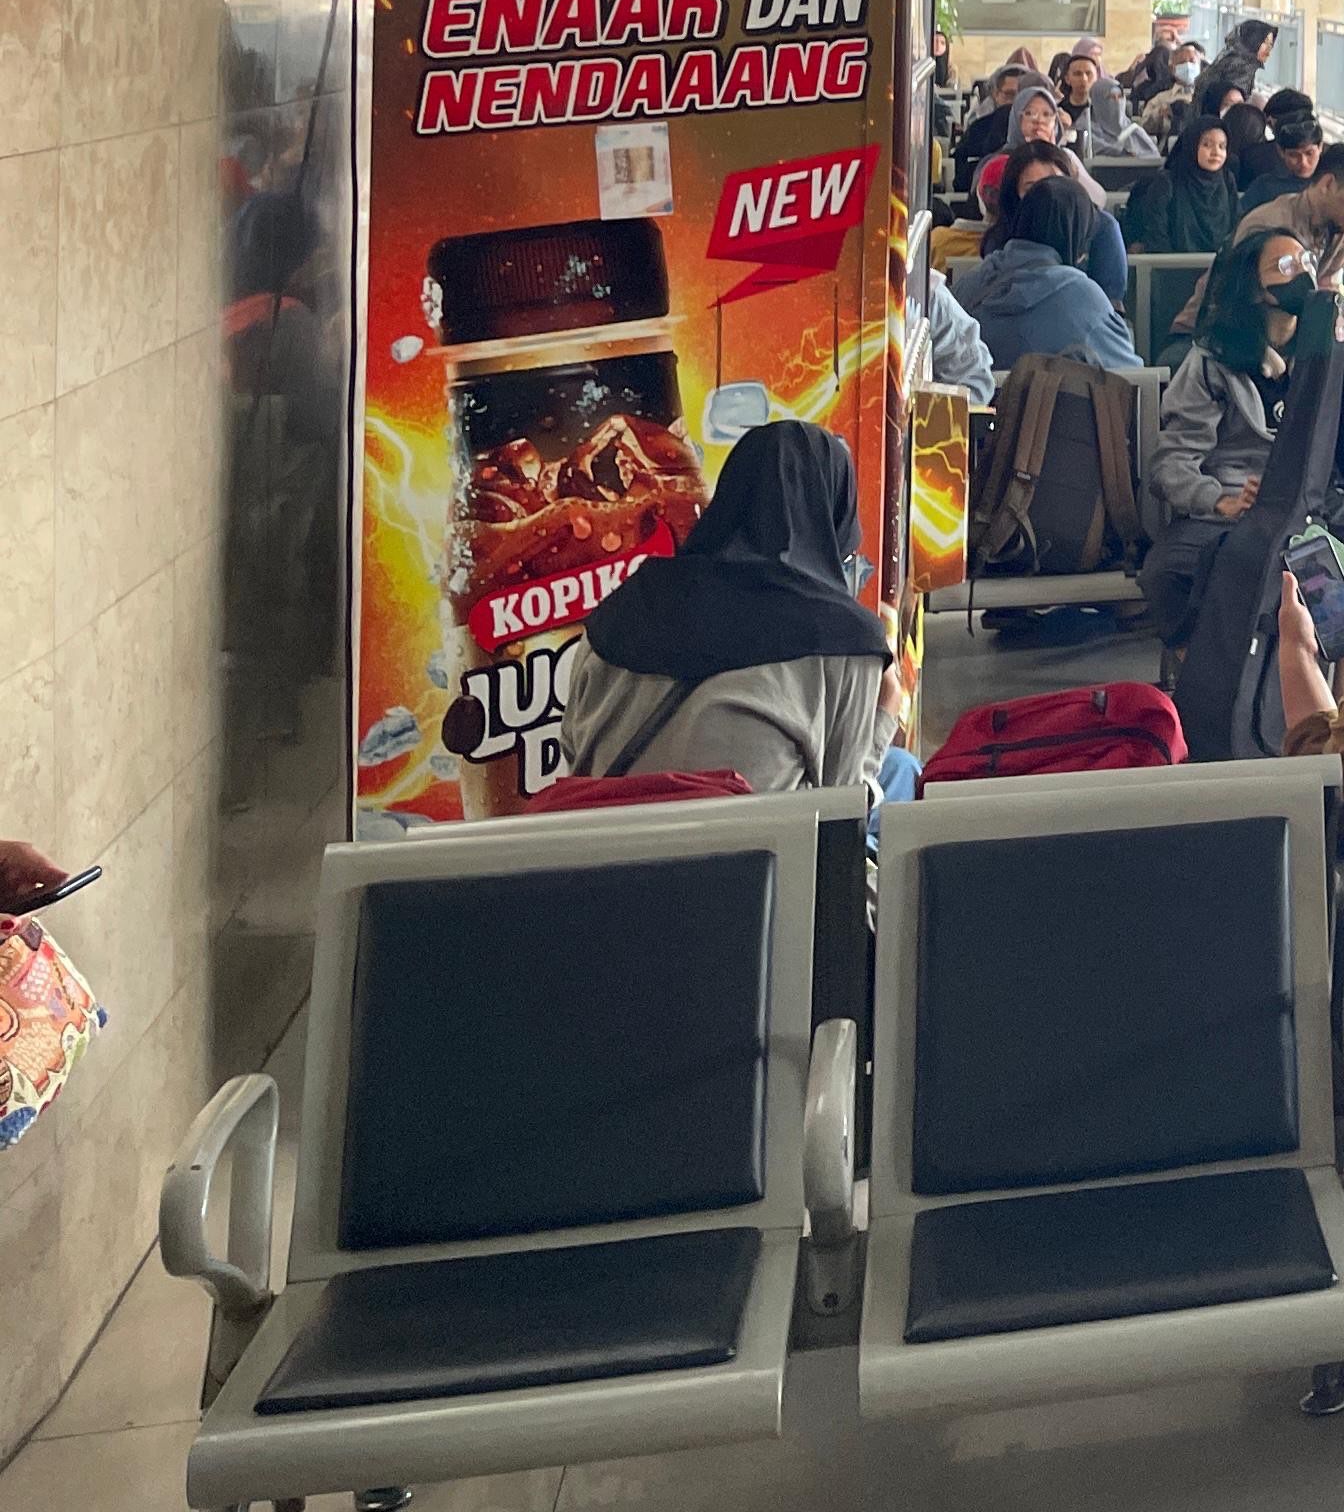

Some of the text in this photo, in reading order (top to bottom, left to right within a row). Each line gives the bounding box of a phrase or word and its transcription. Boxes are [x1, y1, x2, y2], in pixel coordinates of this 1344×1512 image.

[417, 38, 869, 135] NENDAAANG
[728, 159, 861, 238] NEW
[489, 553, 649, 639] KOPIK
